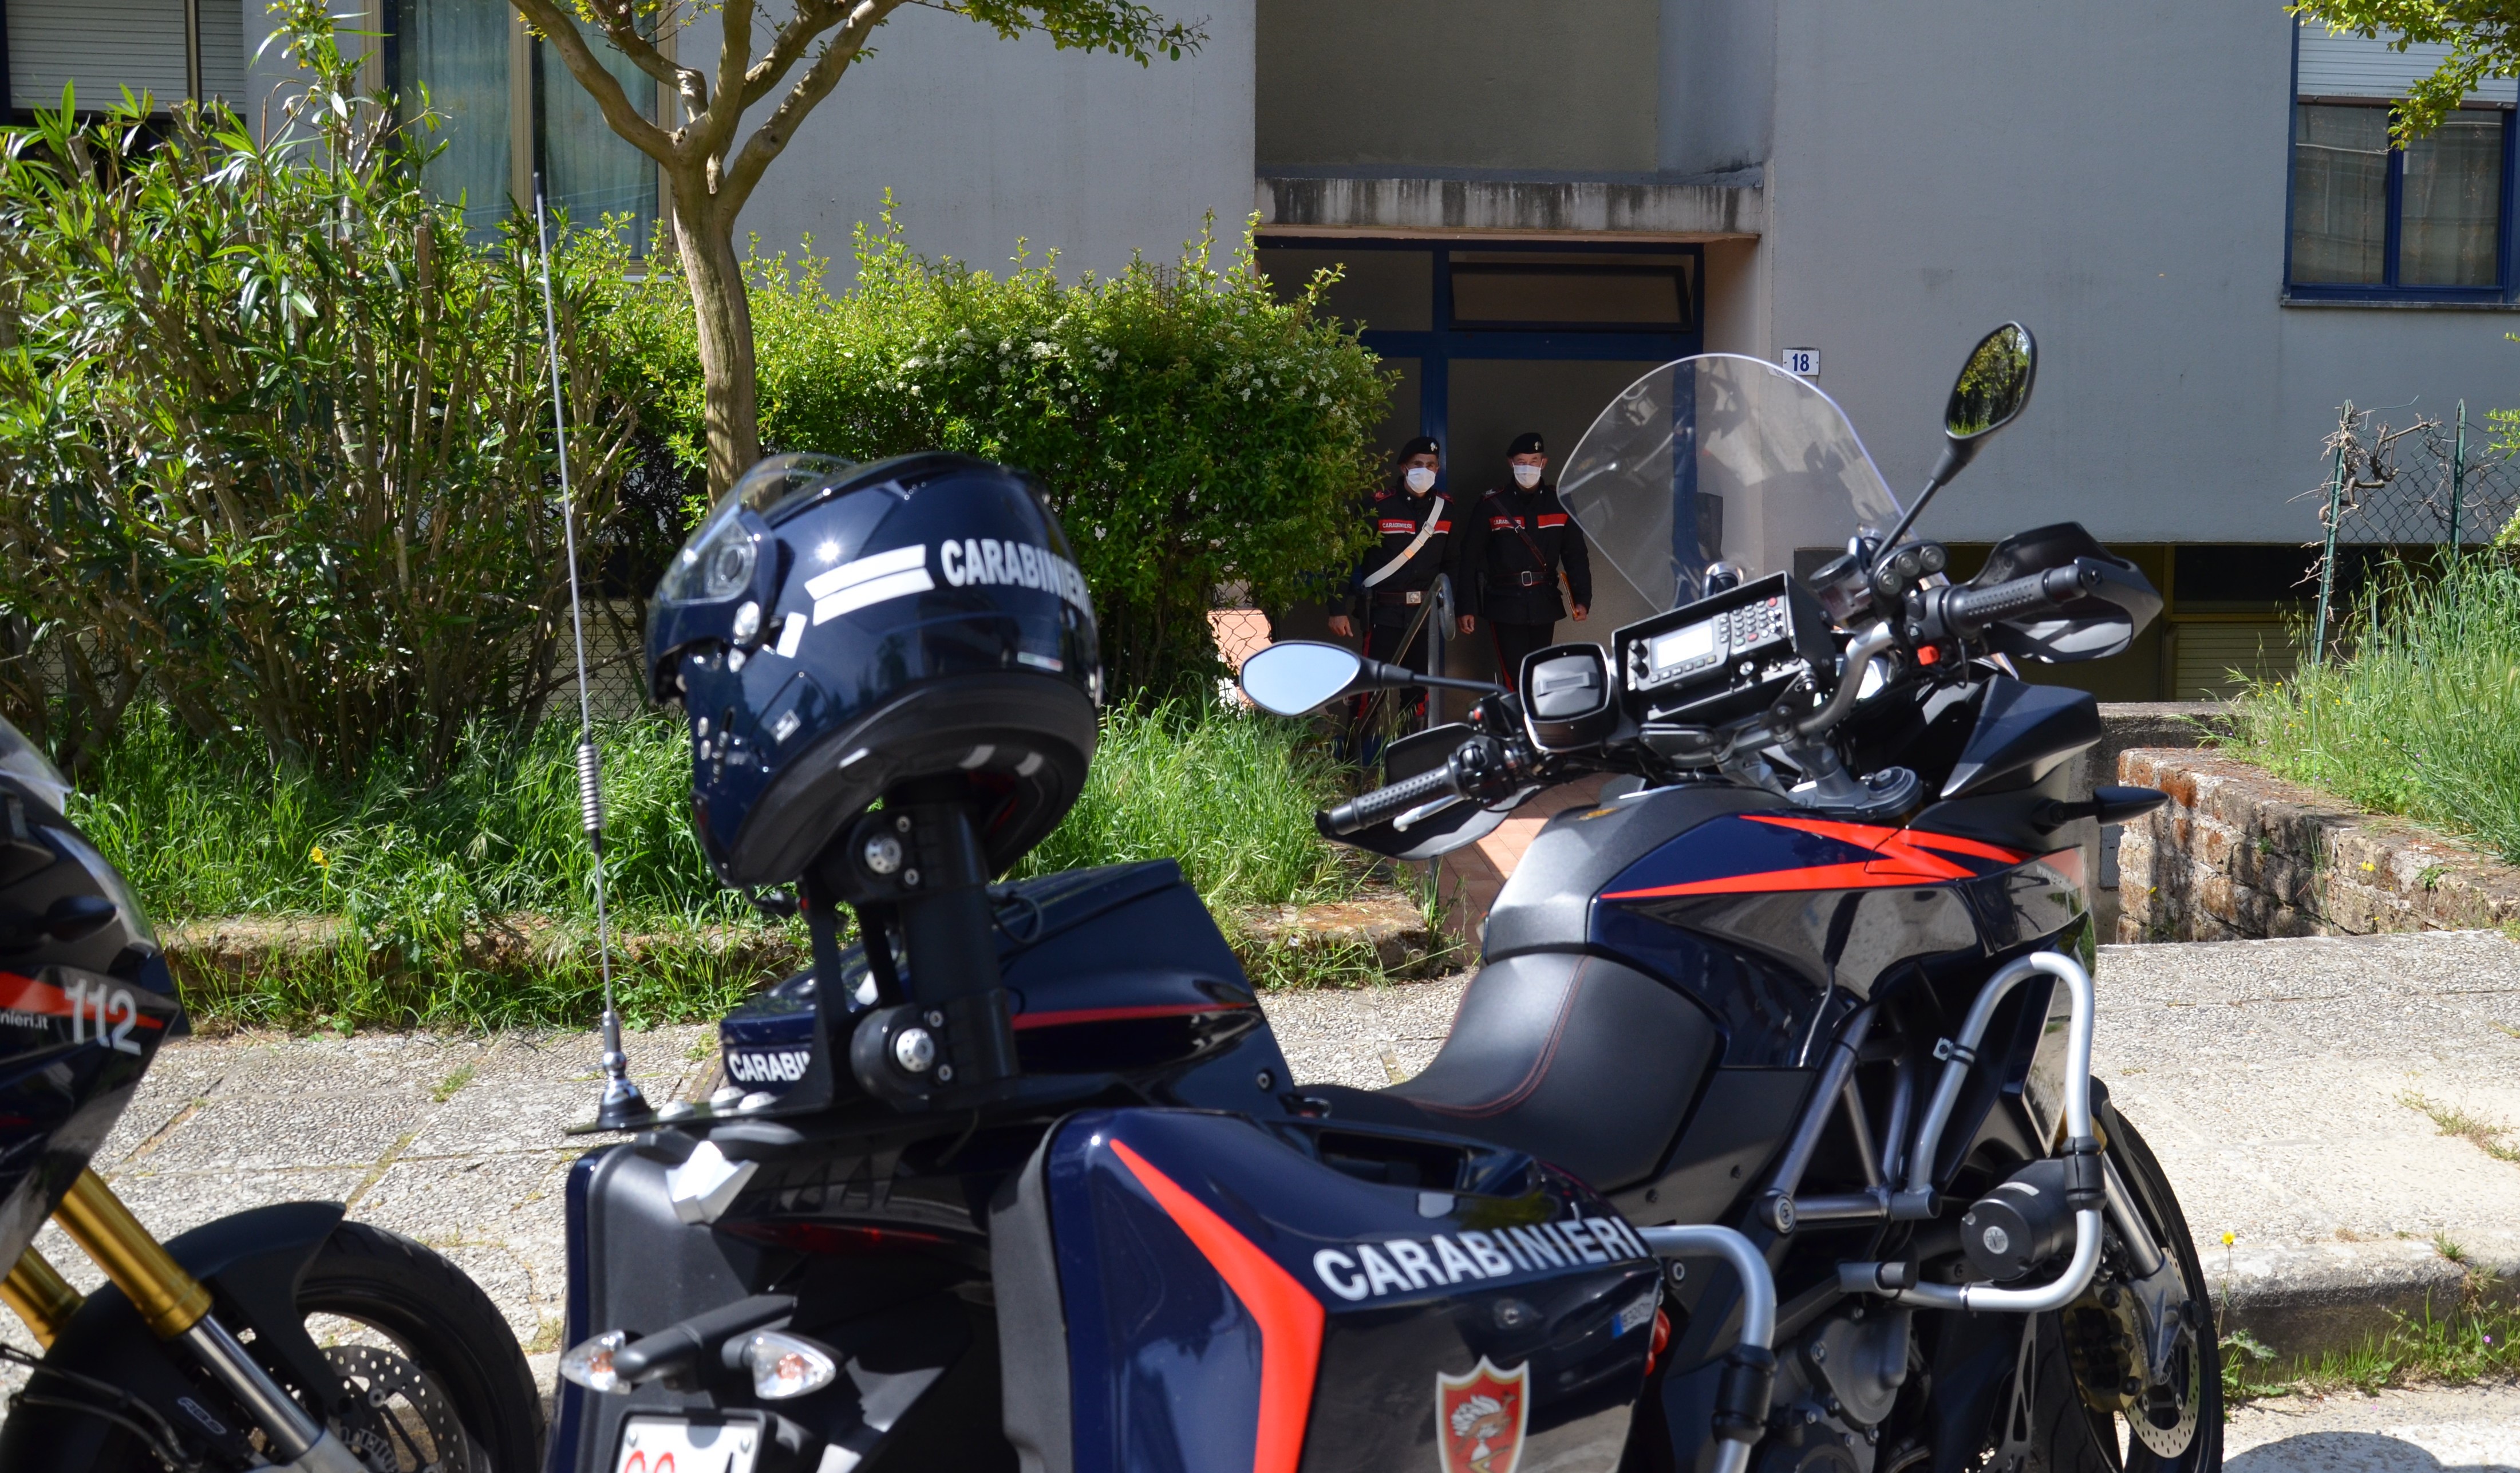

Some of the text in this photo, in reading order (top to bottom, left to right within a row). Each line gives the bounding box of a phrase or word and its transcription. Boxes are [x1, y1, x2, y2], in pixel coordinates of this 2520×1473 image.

[1792, 353, 1810, 372] 18
[0, 1010, 48, 1030] nieri.it
[65, 978, 141, 1056] 112
[729, 1051, 811, 1081] CARABI
[1313, 1217, 1648, 1301] CARABINIERI
